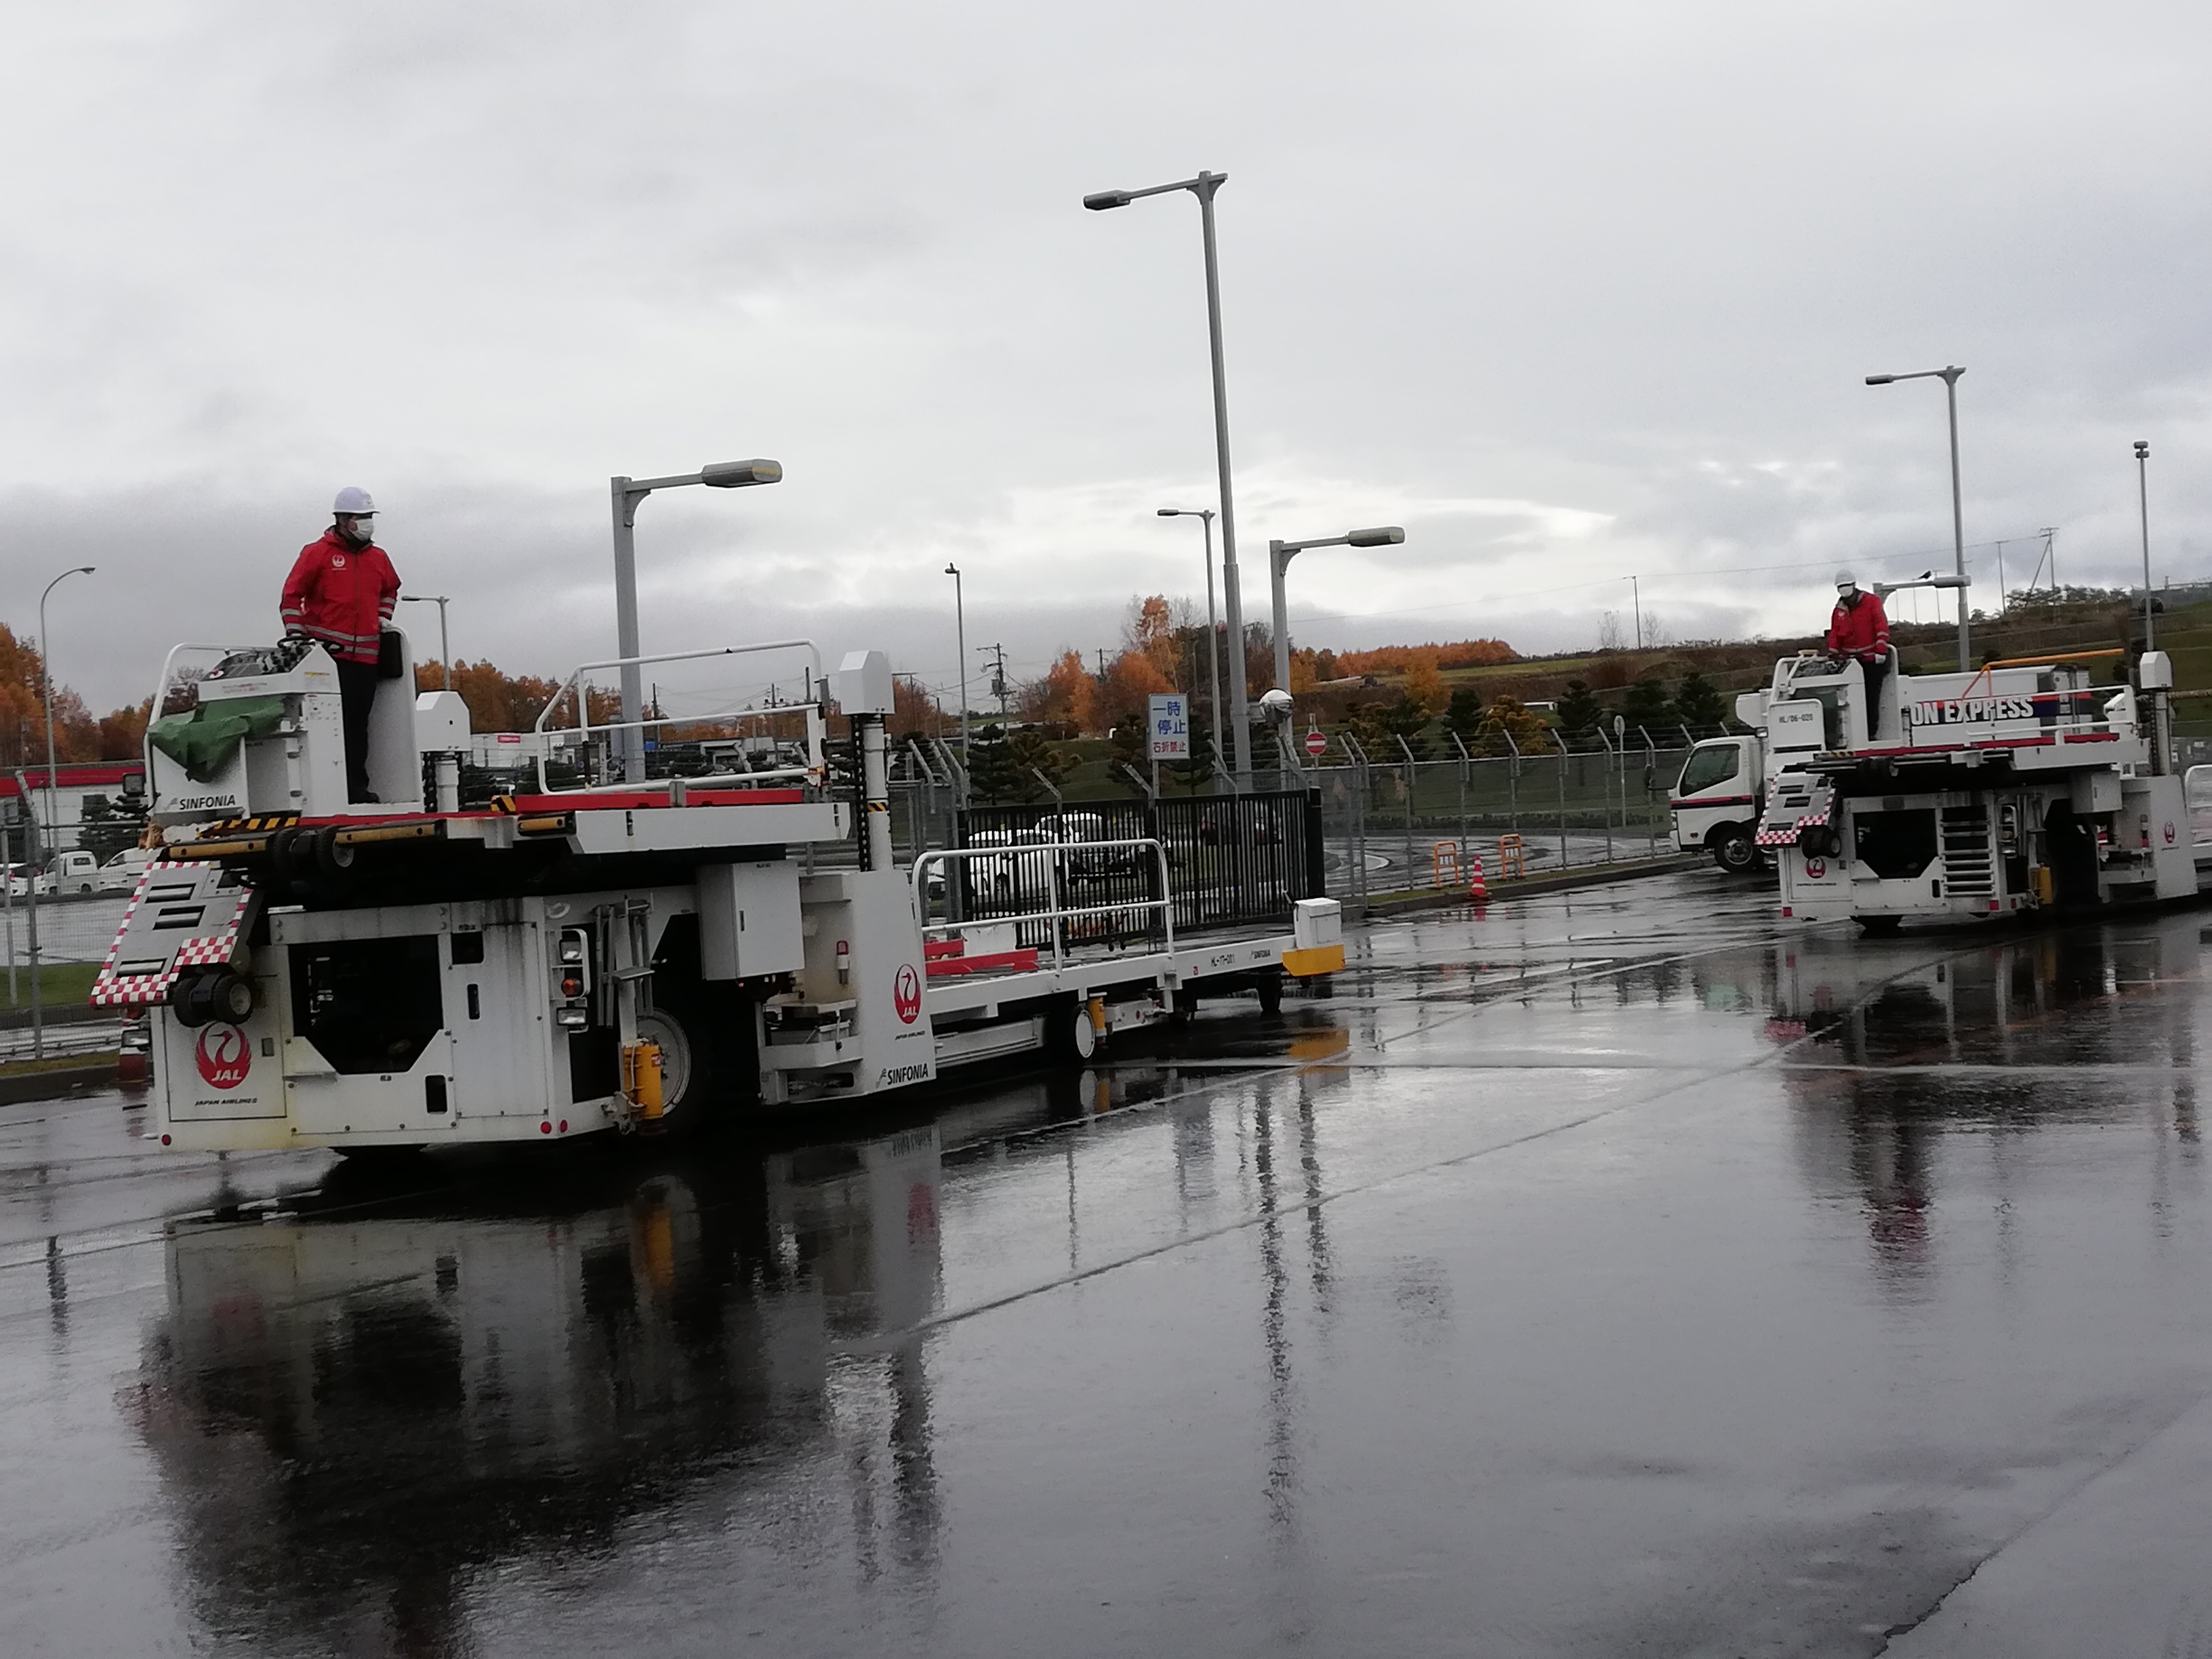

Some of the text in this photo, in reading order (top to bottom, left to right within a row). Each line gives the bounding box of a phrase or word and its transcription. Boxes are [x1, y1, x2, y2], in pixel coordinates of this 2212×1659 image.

[1153, 701, 1181, 716] 一時
[1944, 697, 2034, 723] EXPRESS
[1158, 719, 1187, 735] 停止
[180, 794, 236, 810] SINFONIA
[903, 1006, 918, 1017] JAL
[211, 1069, 242, 1082] JAL
[887, 1063, 928, 1085] SINFONIA
